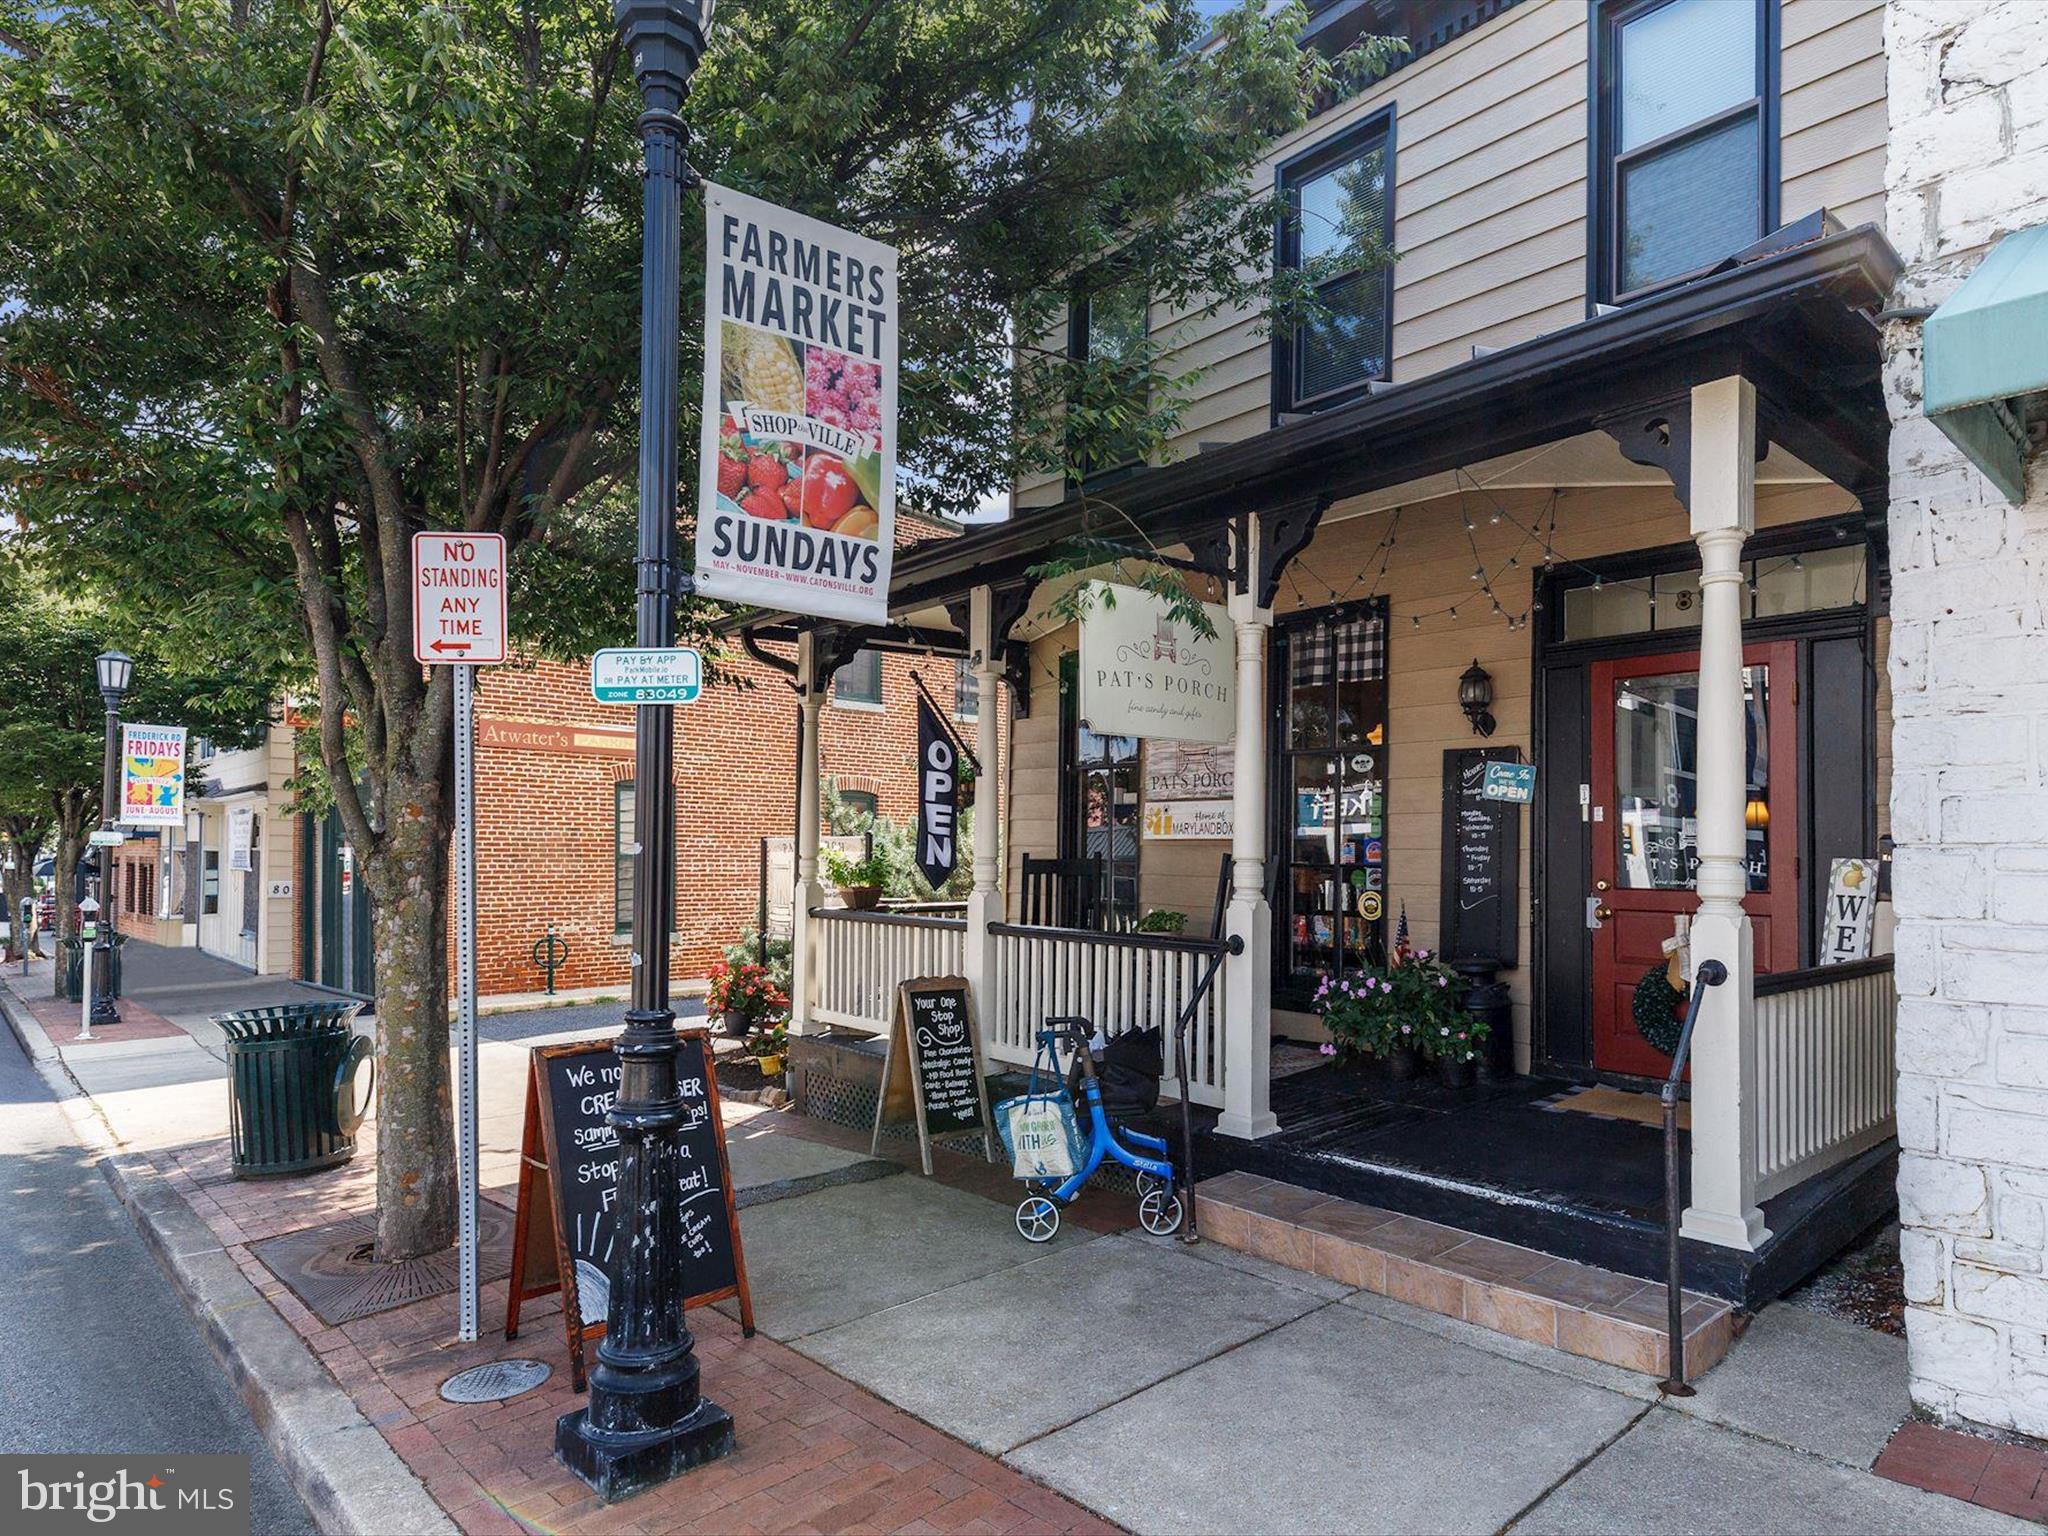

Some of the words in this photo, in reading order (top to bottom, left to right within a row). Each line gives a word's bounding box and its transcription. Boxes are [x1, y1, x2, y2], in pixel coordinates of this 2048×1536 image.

[723, 214, 885, 306] FARMERS
[722, 264, 887, 360] MARKET
[751, 413, 797, 435] SHOP
[807, 422, 856, 456] VILLE
[443, 542, 475, 562] NO
[711, 516, 879, 584] SUNDAYS
[421, 568, 498, 588] STANDING
[440, 597, 480, 613] ANY
[440, 619, 482, 636] TIME
[616, 656, 636, 665] PAY
[656, 655, 677, 665] APP
[617, 675, 638, 685] PAY
[641, 675, 654, 684] AT
[656, 674, 689, 684] METER
[607, 691, 629, 699] ZONE
[635, 688, 688, 700] 83049
[1164, 675, 1228, 703] PORCH
[127, 731, 168, 740] FREDERICK
[170, 733, 181, 741] RD
[482, 724, 569, 748] Atwater's
[127, 740, 181, 758] FRIDAYS
[1193, 771, 1234, 788] PORC
[1490, 765, 1516, 779] Come
[1516, 769, 1531, 780] In
[1462, 787, 1483, 796] Sunda
[1486, 784, 1529, 800] OPEN
[924, 739, 953, 868] OPEN
[1194, 811, 1215, 822] Home
[1217, 810, 1226, 822] of
[272, 884, 290, 895] 80
[1833, 894, 1867, 963] WE
[914, 997, 937, 1011] Your
[940, 996, 958, 1009] One
[930, 1010, 954, 1025] Stop
[937, 1020, 965, 1038] Shop!
[565, 1065, 596, 1088] We
[580, 1090, 621, 1115] CRE
[680, 1144, 693, 1159] a
